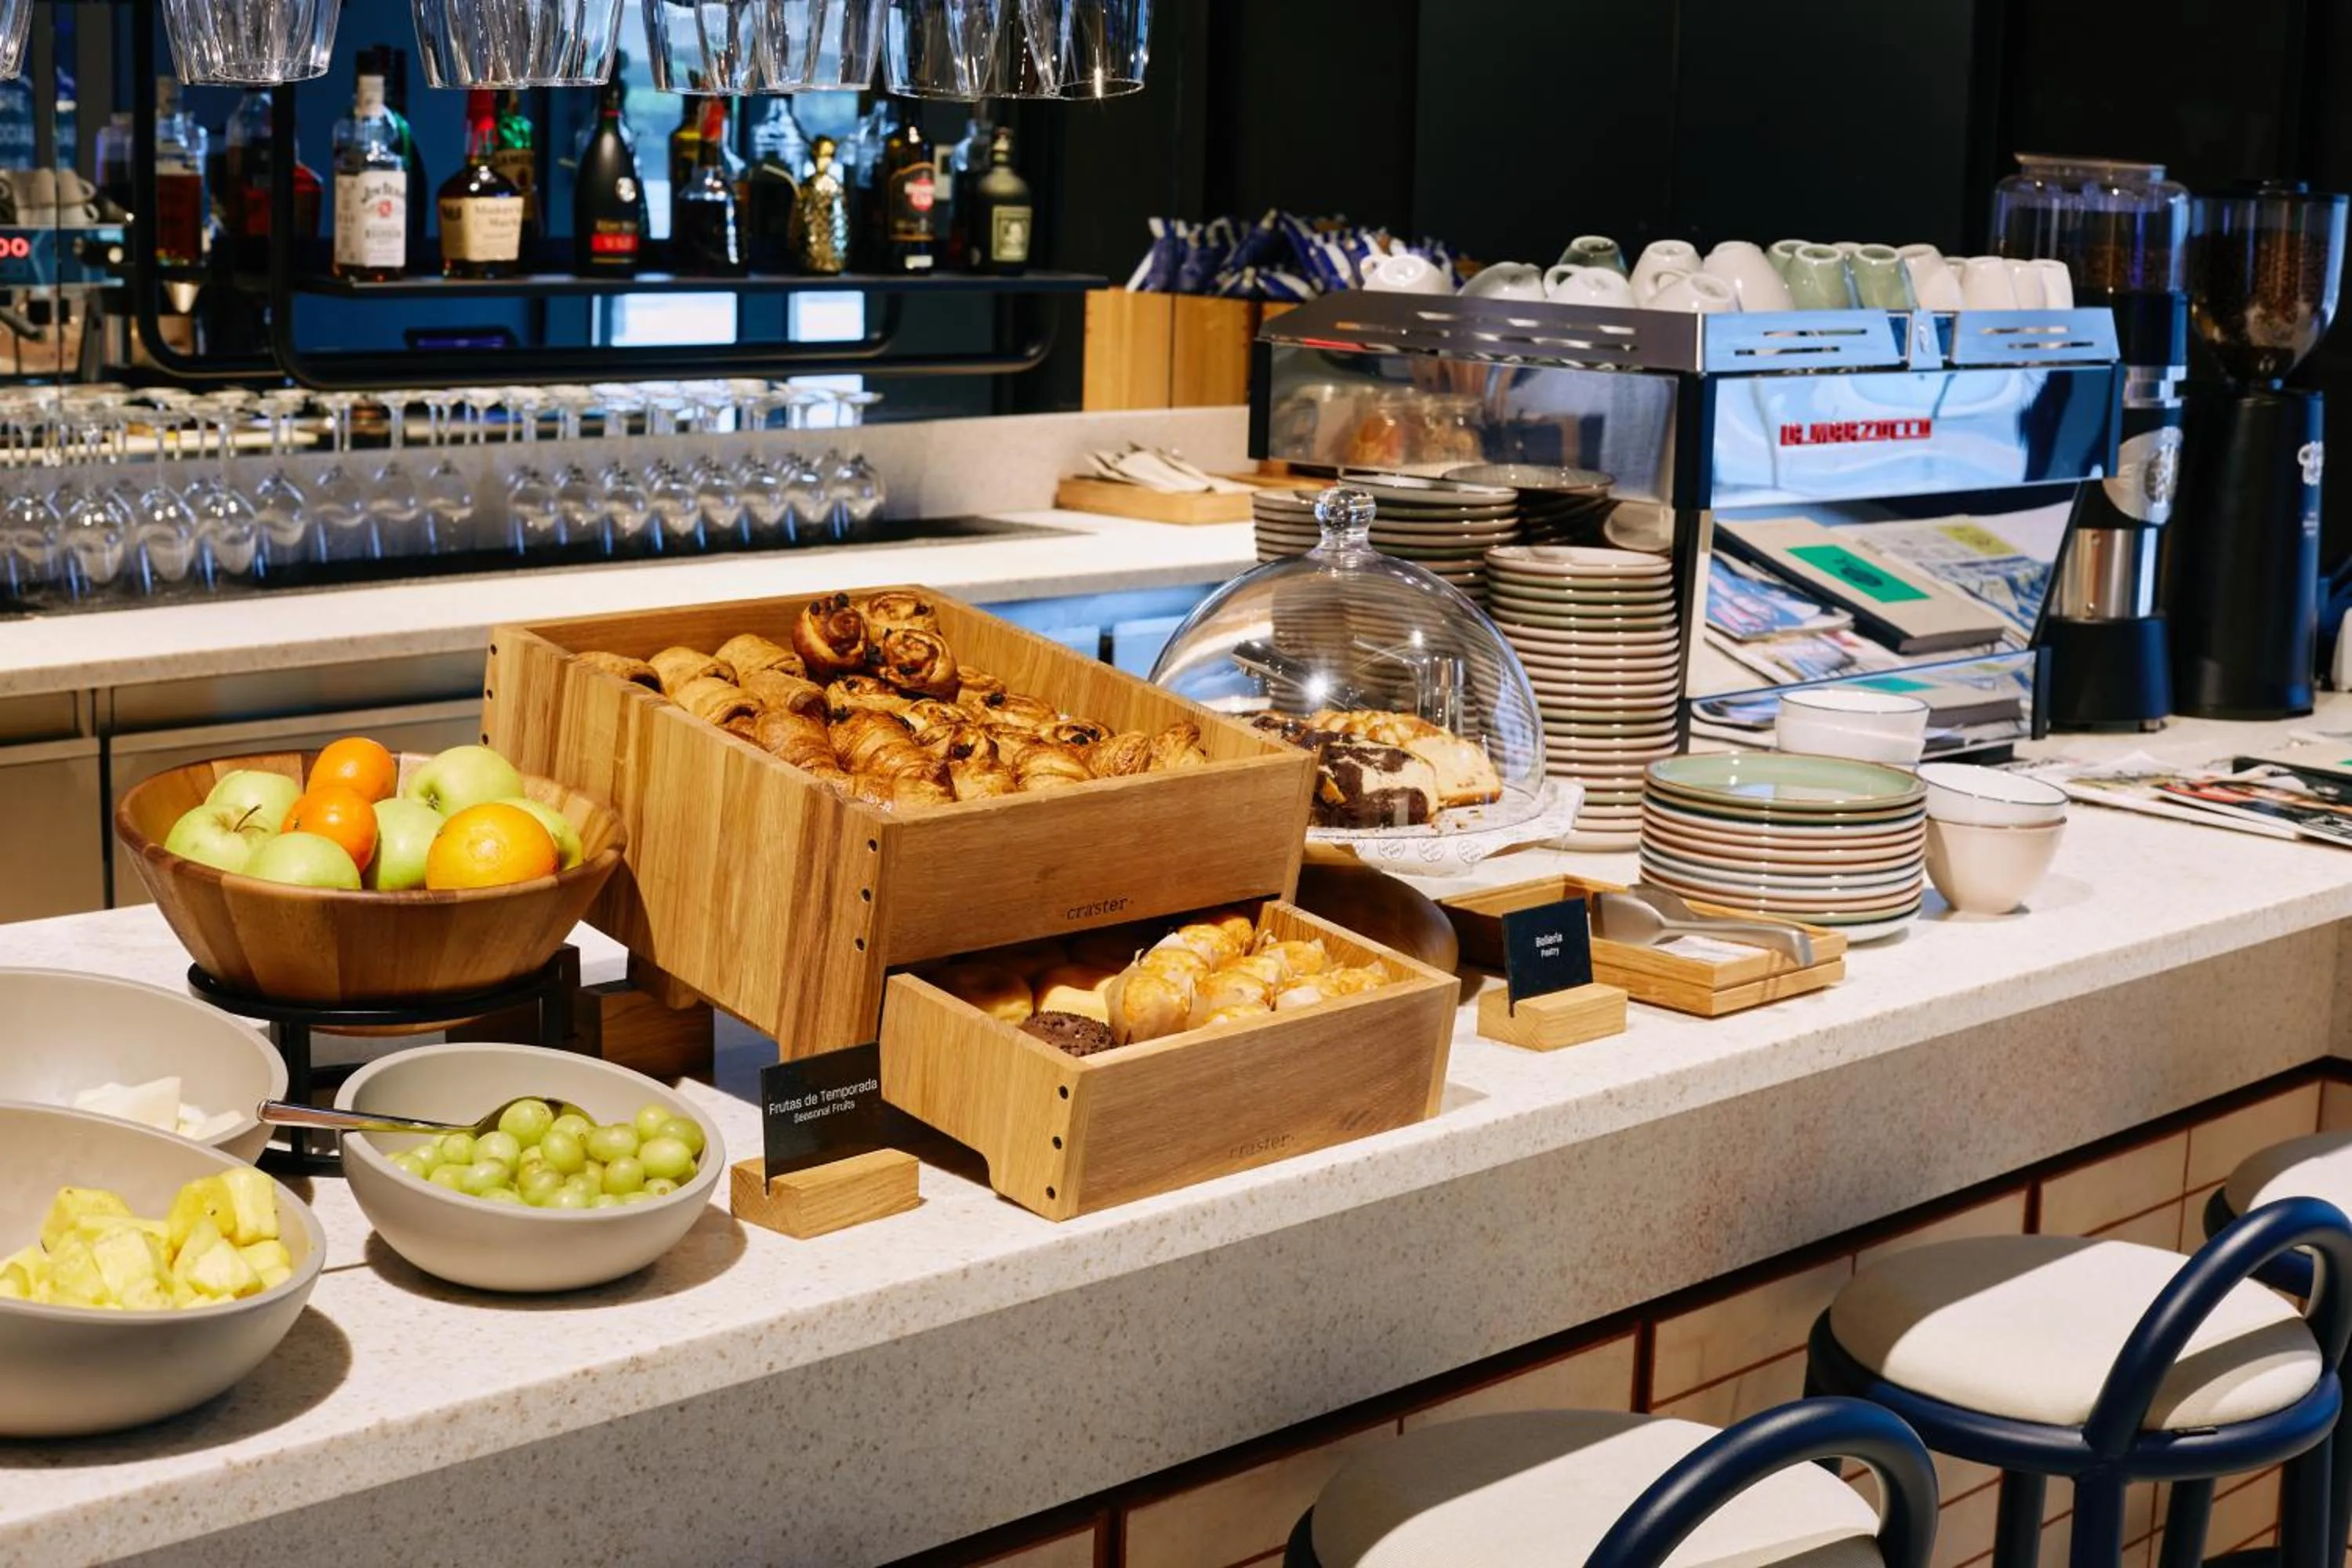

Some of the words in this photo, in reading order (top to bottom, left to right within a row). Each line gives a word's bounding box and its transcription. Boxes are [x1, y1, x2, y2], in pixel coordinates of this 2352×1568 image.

[1067, 897, 1127, 920] craster
[1541, 947, 1559, 958] Pastry
[769, 1098, 802, 1116] Frutas
[804, 1094, 818, 1107] de
[821, 1079, 877, 1102] Temporada
[793, 1107, 831, 1124] Seasonal
[832, 1100, 855, 1114] Fruits
